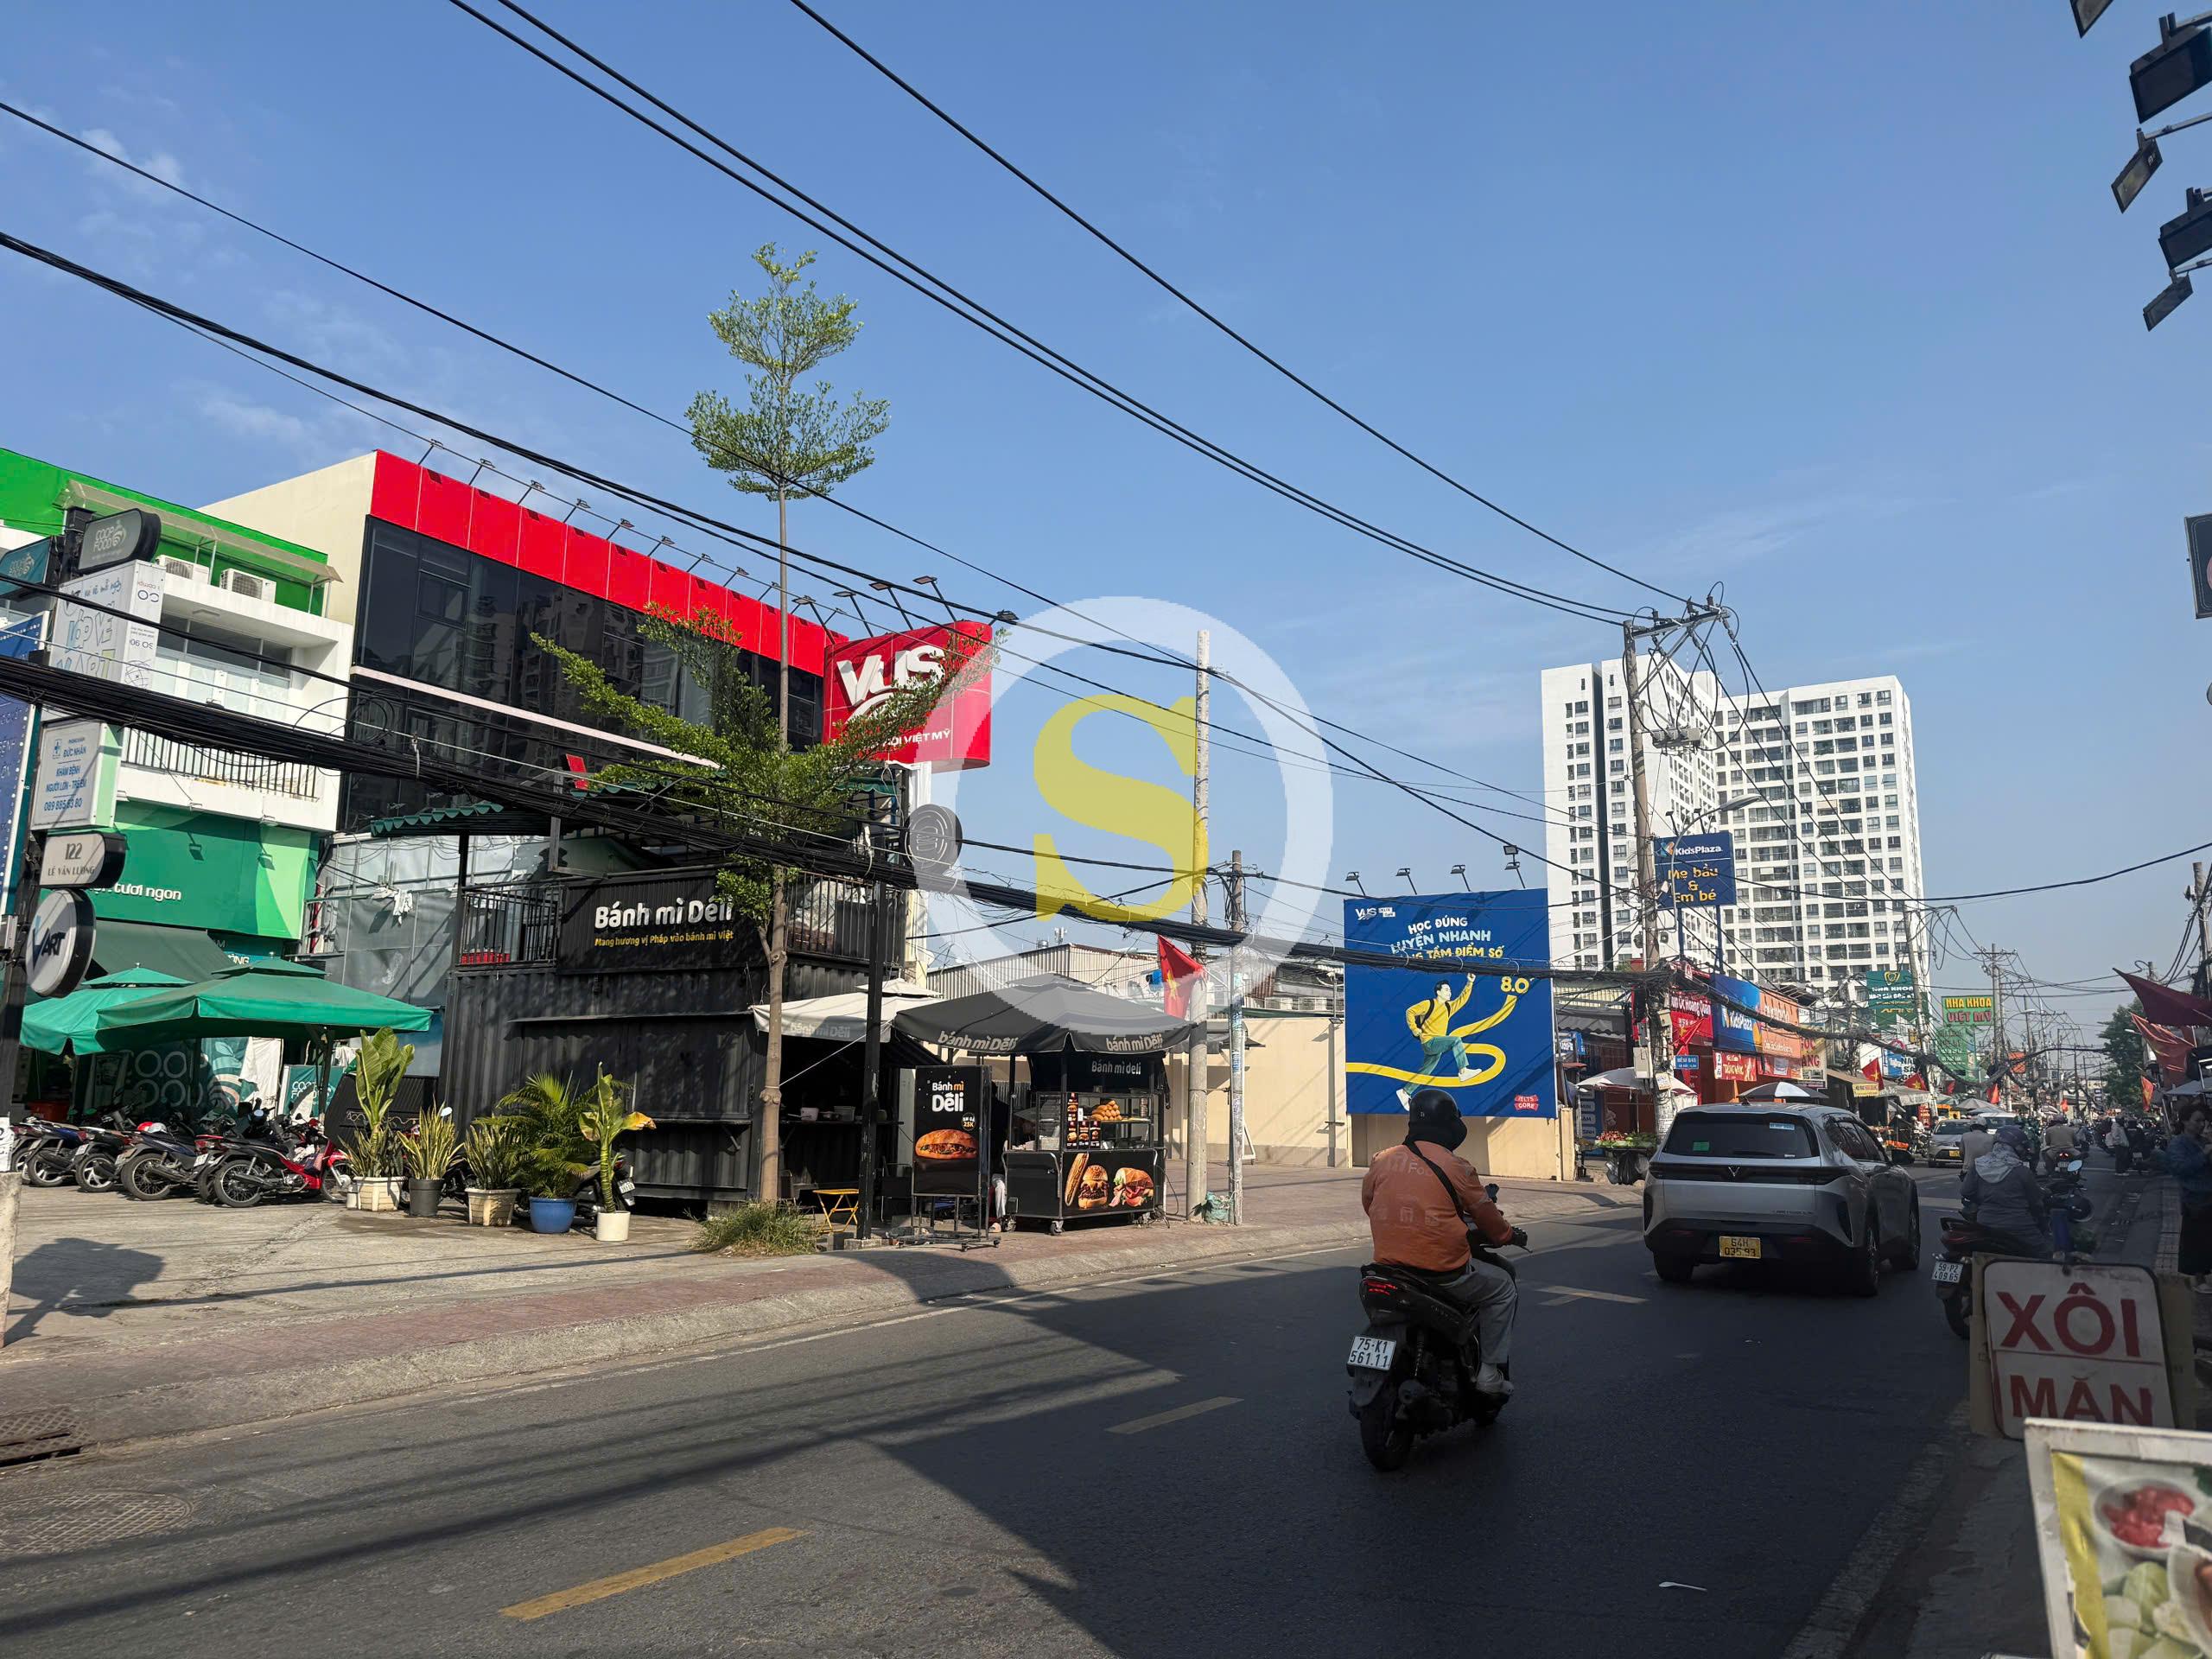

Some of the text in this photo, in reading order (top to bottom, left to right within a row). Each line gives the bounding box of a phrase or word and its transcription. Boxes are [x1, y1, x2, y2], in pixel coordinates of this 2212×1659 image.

[836, 645, 945, 705] VUS
[903, 732, 931, 744] VIỆT
[931, 728, 950, 741] MỸ
[65, 843, 83, 860] 122
[1675, 846, 1722, 855] KidsPlaza
[114, 882, 143, 896] tươi
[146, 887, 181, 901] ngon
[1688, 880, 1699, 891] &
[1699, 888, 1717, 901] bé
[594, 901, 651, 929] Bánh
[655, 897, 685, 925] mì
[1408, 915, 1468, 934] HỌC ĐÚNG
[594, 929, 734, 947] Mang hương vị Pháp vào bánh mì Việt
[1439, 930, 1491, 943] NHANH
[1427, 944, 1452, 959] TẦM
[1455, 942, 1484, 957] ĐIỂM
[1488, 944, 1505, 958] SỐ
[1946, 997, 1991, 1008] NHA KHOA
[938, 1031, 971, 1048] bánh
[971, 1035, 991, 1049] mì
[1106, 1036, 1130, 1052] bánh
[1131, 1035, 1144, 1051] mì
[1091, 1059, 1141, 1075] Bánh mì deli
[932, 1080, 964, 1091] Bánh mì
[1996, 1282, 2141, 1357] XÔI
[1350, 1351, 1389, 1368] 561.11
